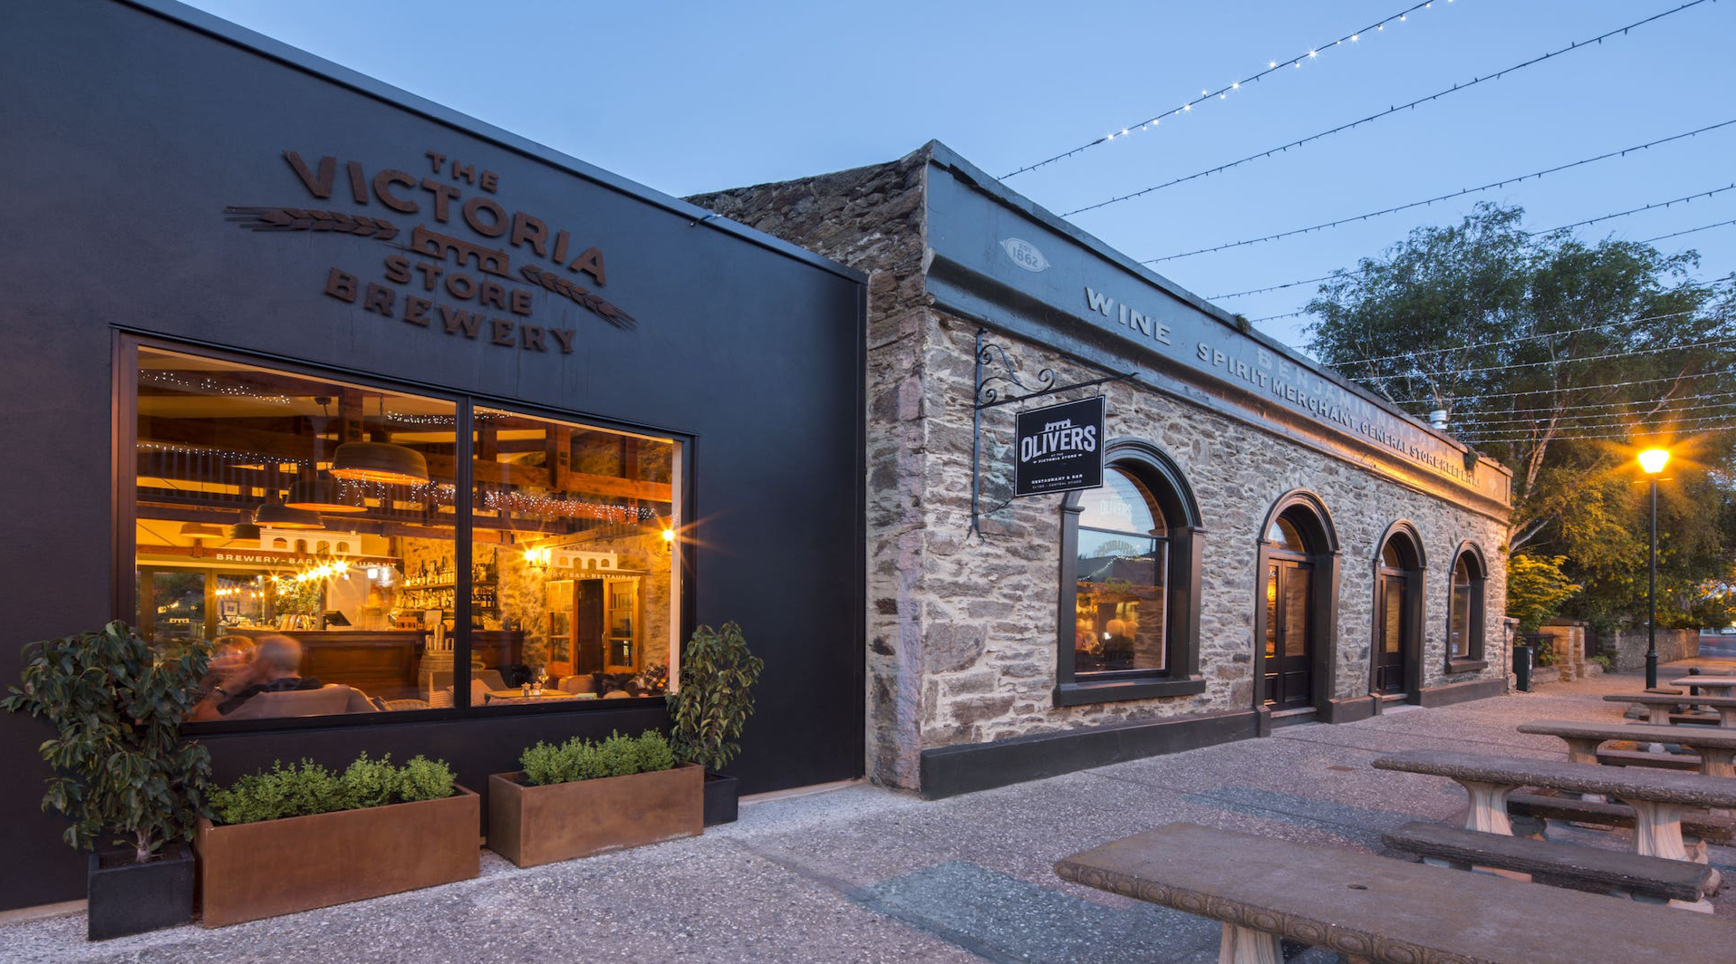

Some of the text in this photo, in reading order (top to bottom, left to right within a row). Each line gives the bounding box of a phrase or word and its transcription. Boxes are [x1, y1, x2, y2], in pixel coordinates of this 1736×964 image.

[425, 150, 500, 193] THE
[281, 150, 607, 288] VICTORIA
[1012, 246, 1039, 268] 1862
[323, 266, 577, 354] BREWERY
[384, 253, 534, 316] STORE
[1084, 286, 1172, 346] WINE
[1196, 342, 1268, 388] SPIRIT
[1360, 421, 1409, 455] GENERAL
[1257, 347, 1371, 420] BENJAMIN
[1021, 425, 1096, 463] OLIVERS
[1031, 476, 1065, 484] RESTAURANT
[216, 553, 280, 564] BREWERY
[288, 557, 312, 565] BAR
[591, 573, 642, 581] RESTAURANT
